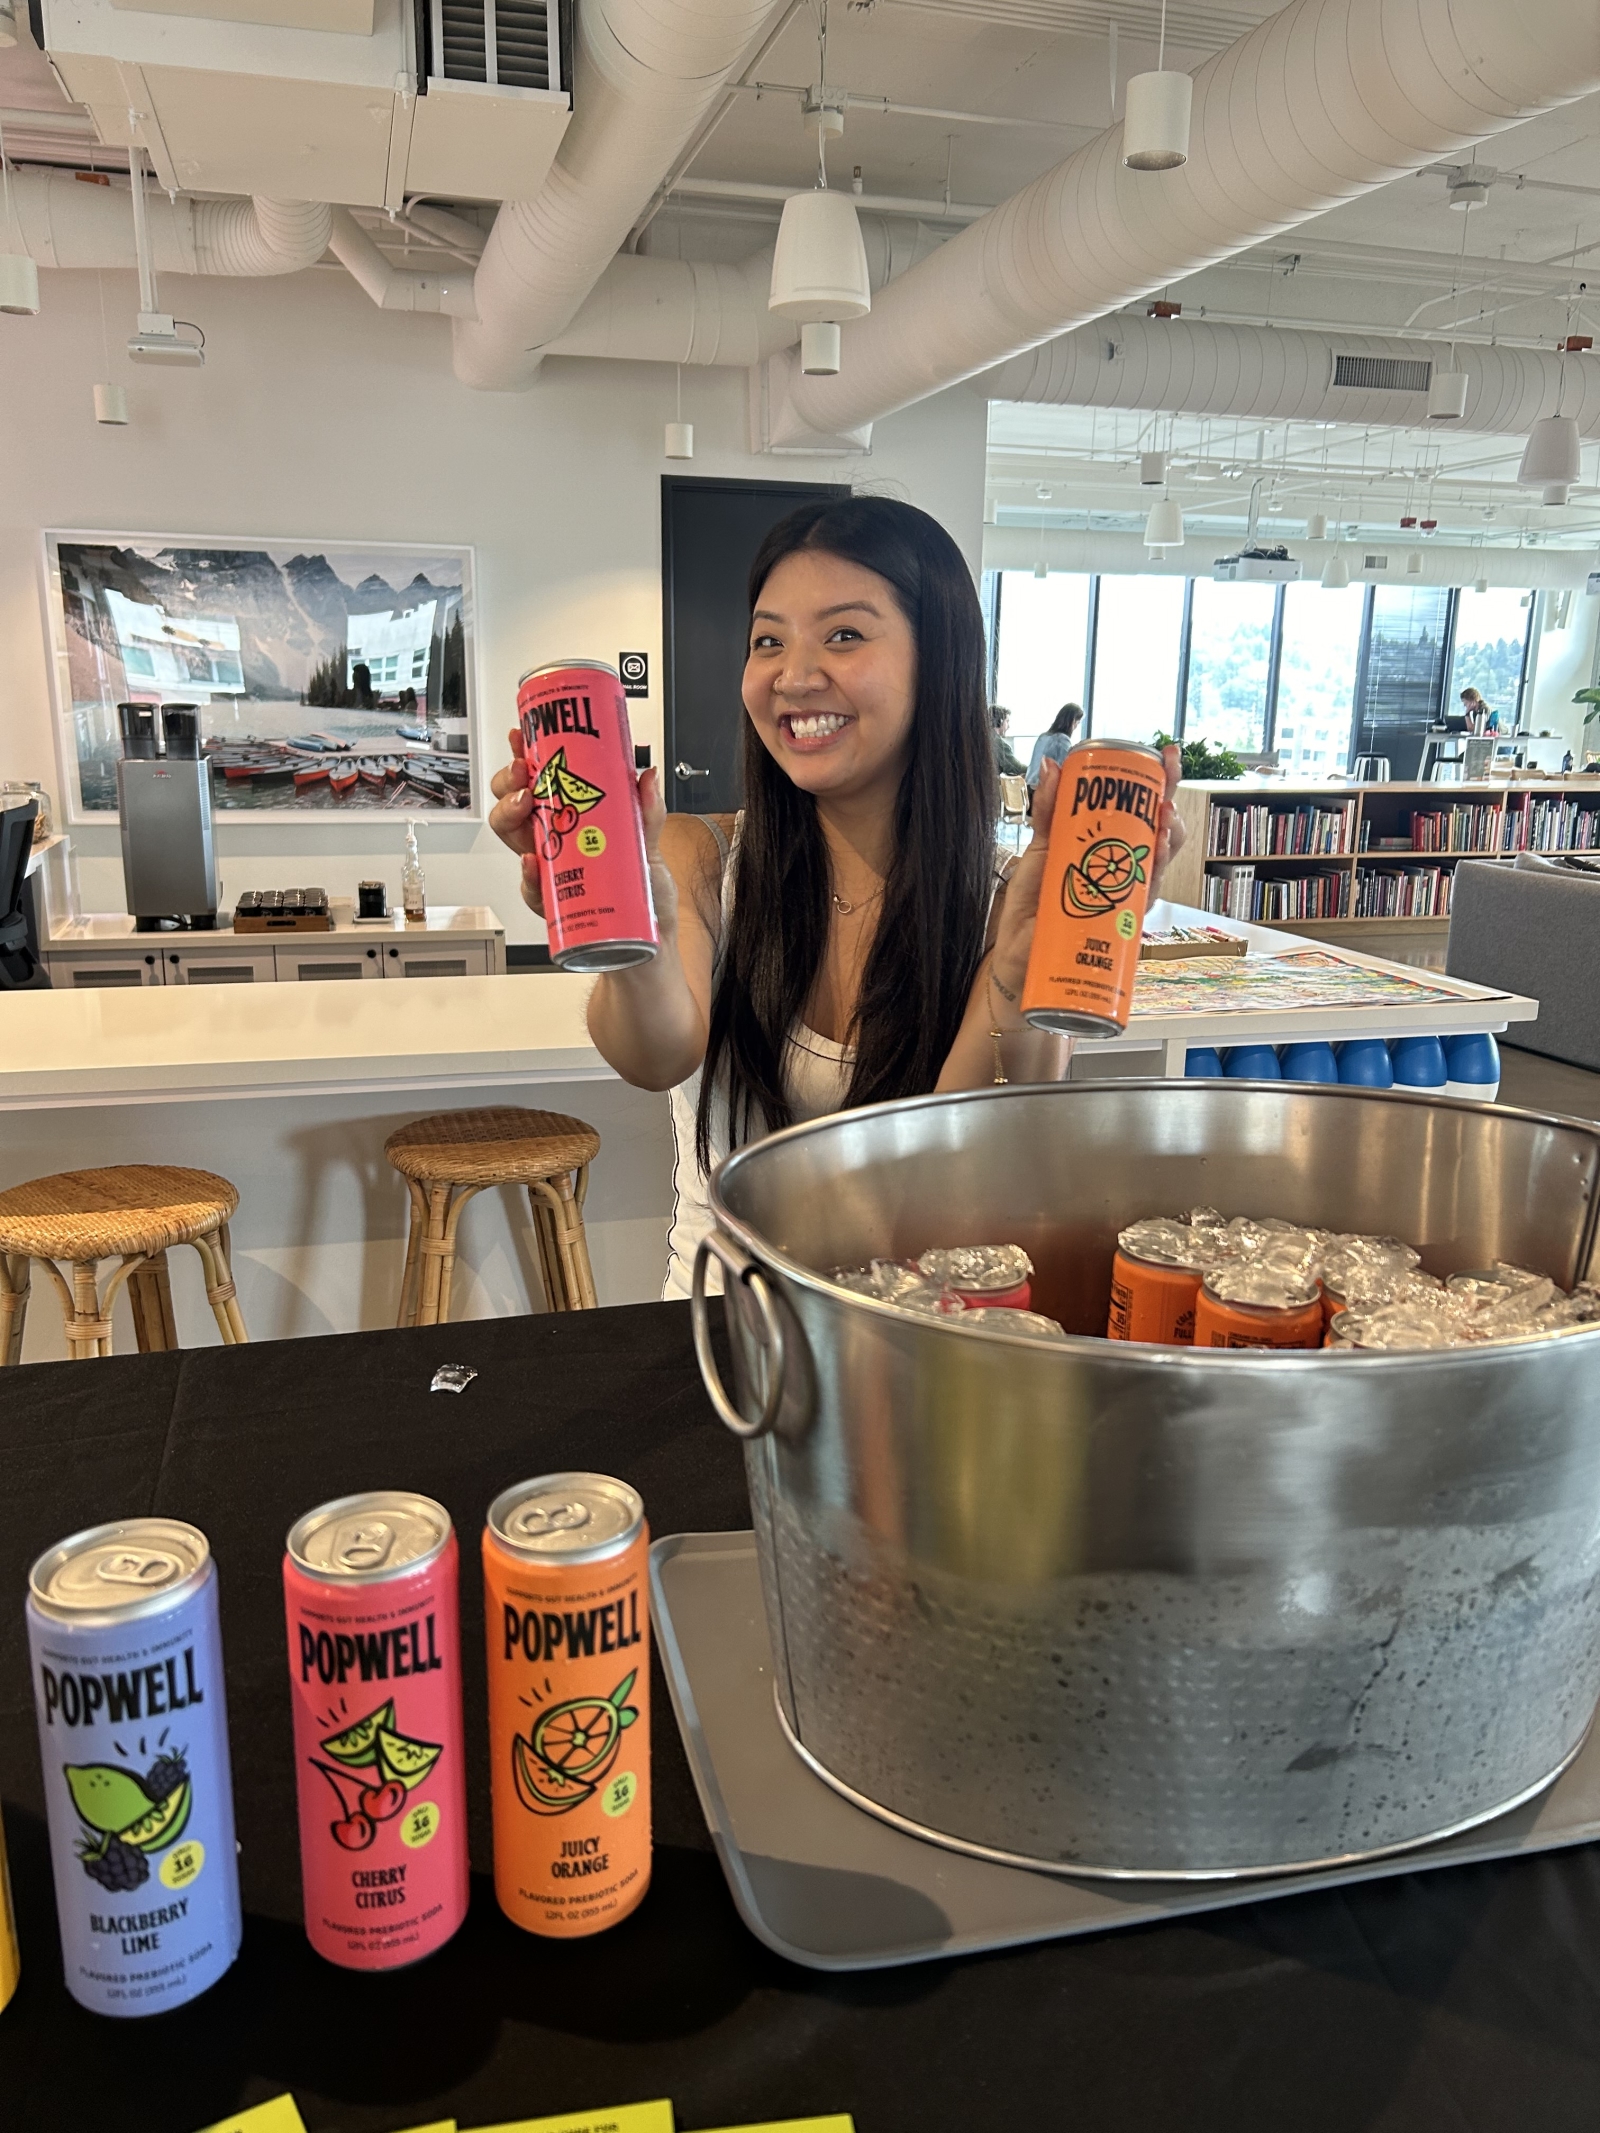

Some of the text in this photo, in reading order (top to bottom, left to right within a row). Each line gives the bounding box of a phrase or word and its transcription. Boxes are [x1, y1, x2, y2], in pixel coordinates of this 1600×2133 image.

[1071, 776, 1159, 834] POPWELL
[554, 867, 584, 887] CHERRY
[557, 883, 586, 902] CITRUS
[598, 907, 615, 915] SODA
[1083, 938, 1111, 954] JUICY
[1075, 952, 1113, 971] ORANGE
[504, 1588, 641, 1661] POPWELL
[299, 1613, 442, 1685] POPWELL
[40, 1645, 203, 1727] POPWELL
[560, 1836, 600, 1858] JUICY
[352, 1864, 407, 1888] CHERRY
[551, 1853, 609, 1878] ORANGE
[355, 1886, 406, 1909] CITRUS
[519, 1868, 639, 1905] FLAVORED PREBIOTIC SODA
[90, 1896, 188, 1934] BLACKBERRY
[322, 1903, 443, 1935] FLAVORED PREBIOTIC SODA
[121, 1932, 160, 1956] LIME
[79, 1942, 213, 1983] FLAVORED PREBIOTIC SODA
